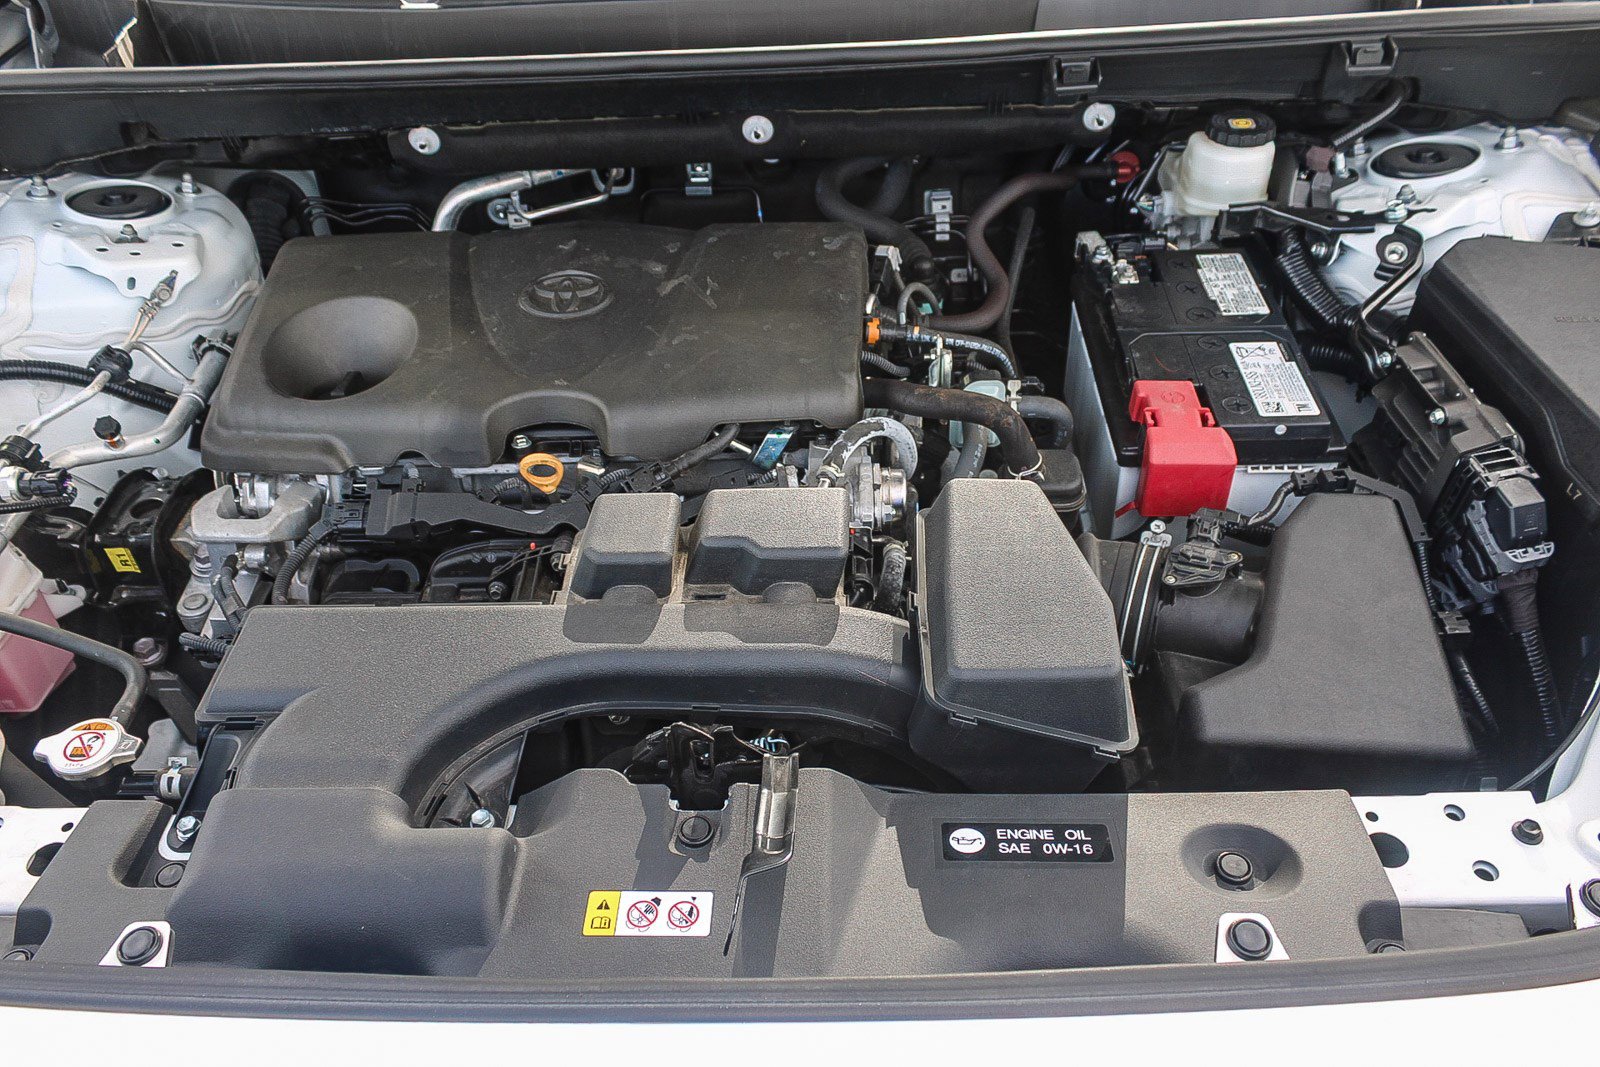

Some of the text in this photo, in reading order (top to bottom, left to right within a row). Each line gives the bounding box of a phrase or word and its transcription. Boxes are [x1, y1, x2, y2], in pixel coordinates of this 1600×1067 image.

[996, 829, 1092, 840] ENGINE OIL
[998, 843, 1094, 855] SAE 0W-16
